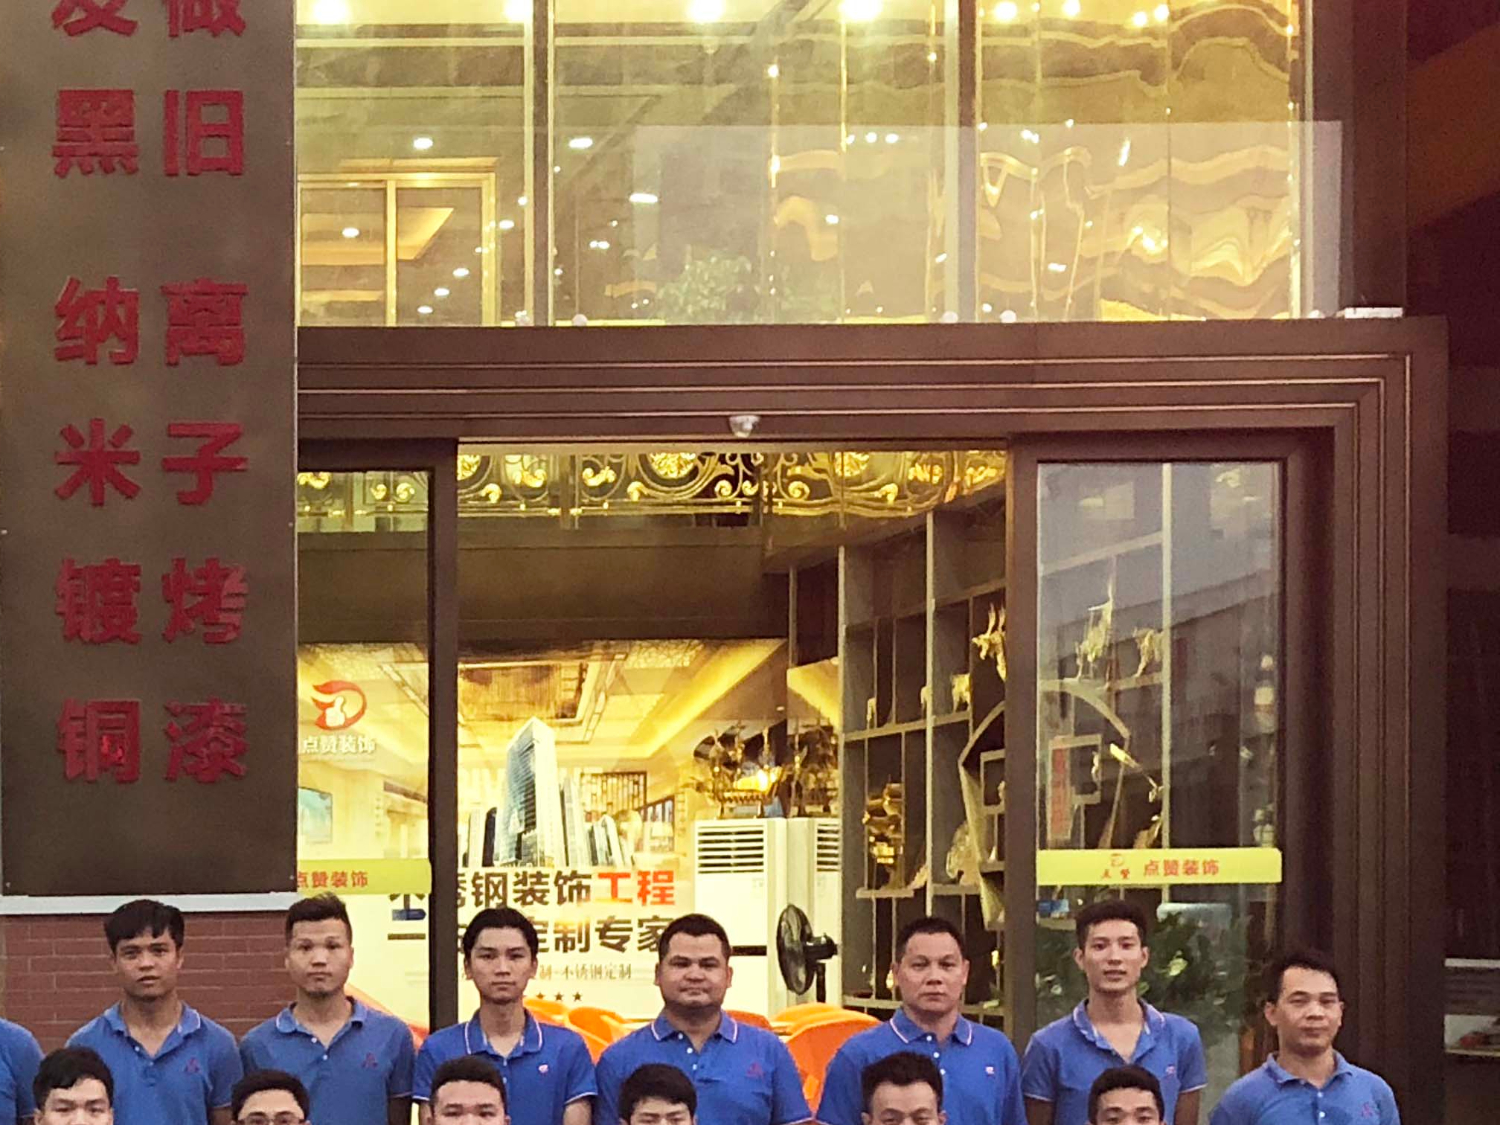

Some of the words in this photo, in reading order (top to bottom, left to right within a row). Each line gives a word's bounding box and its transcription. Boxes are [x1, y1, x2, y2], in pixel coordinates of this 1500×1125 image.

[54, 277, 142, 783] 纳米镀铜
[161, 278, 250, 783] 离子烤漆
[1144, 859, 1220, 877] 点赞装饰
